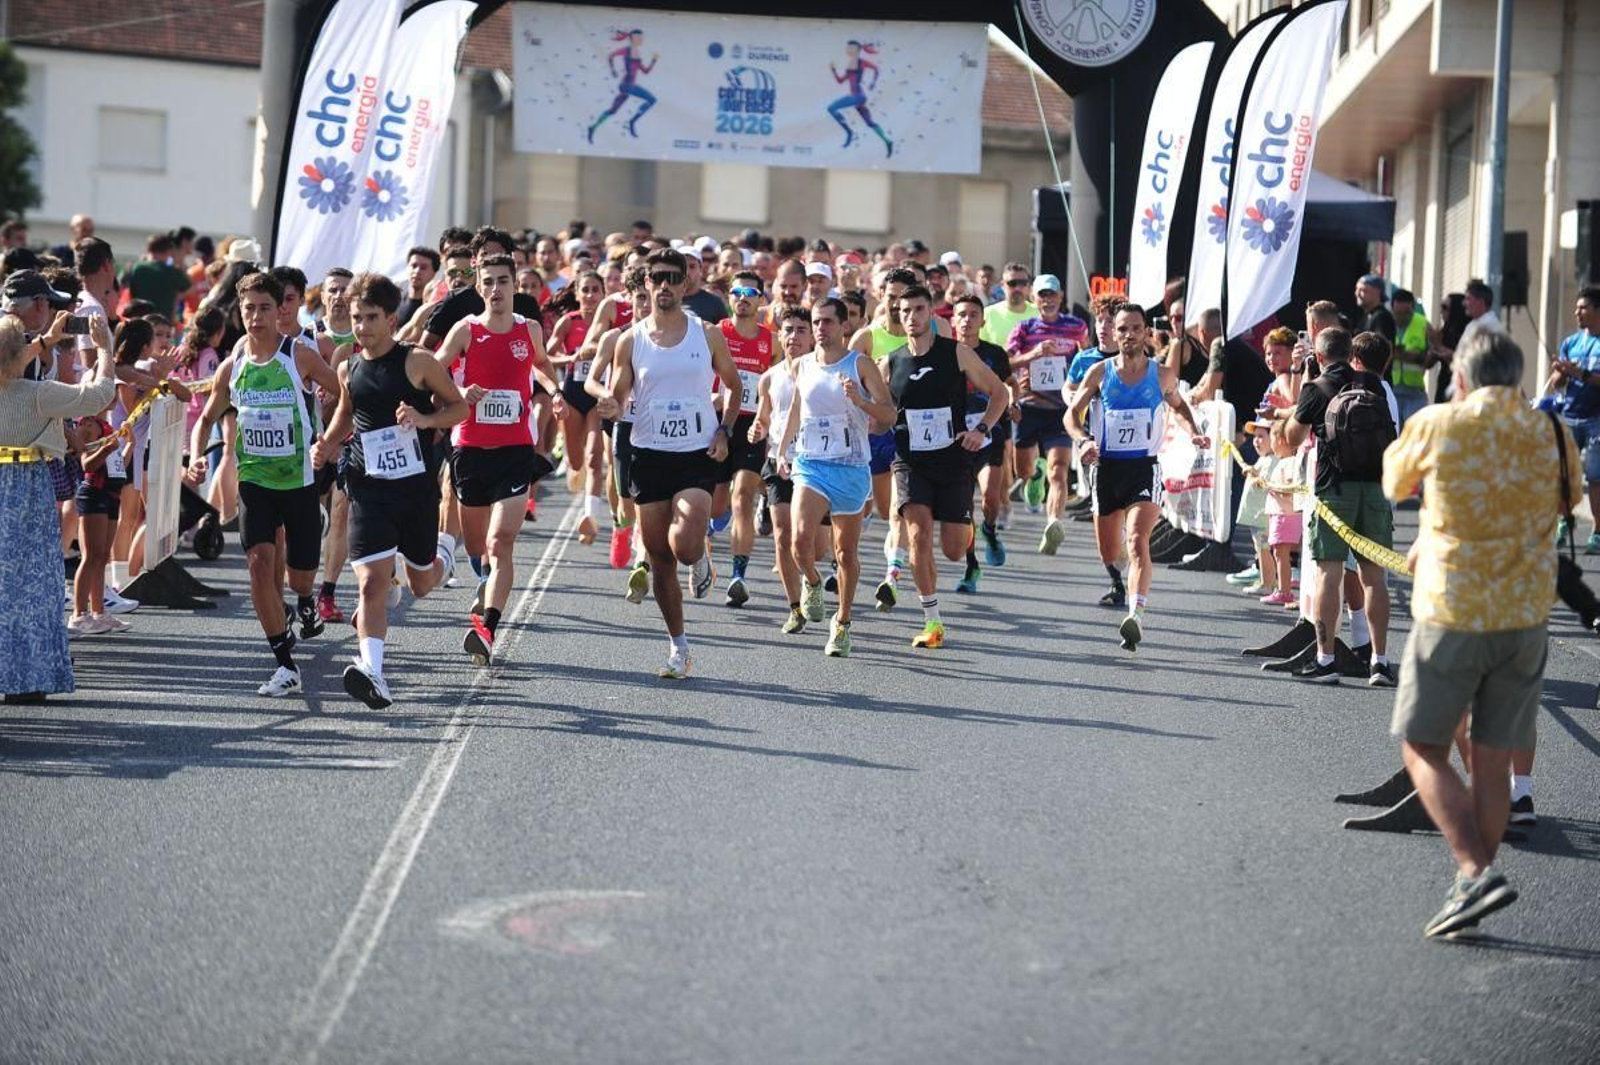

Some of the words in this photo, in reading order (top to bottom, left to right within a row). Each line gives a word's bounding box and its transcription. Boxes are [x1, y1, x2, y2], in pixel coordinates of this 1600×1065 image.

[1061, 42, 1114, 59] OURENSE
[307, 68, 356, 148] chc
[374, 91, 412, 162] chc
[715, 113, 774, 136] 2026
[1247, 110, 1293, 188] chc
[1146, 129, 1174, 194] chc
[1039, 372, 1055, 385] 24
[484, 403, 512, 418] 1004
[244, 428, 285, 448] 3003
[659, 419, 688, 438] 423
[923, 428, 933, 444] 4
[1118, 428, 1135, 445] 27
[820, 435, 829, 452] 7
[376, 447, 409, 474] 455
